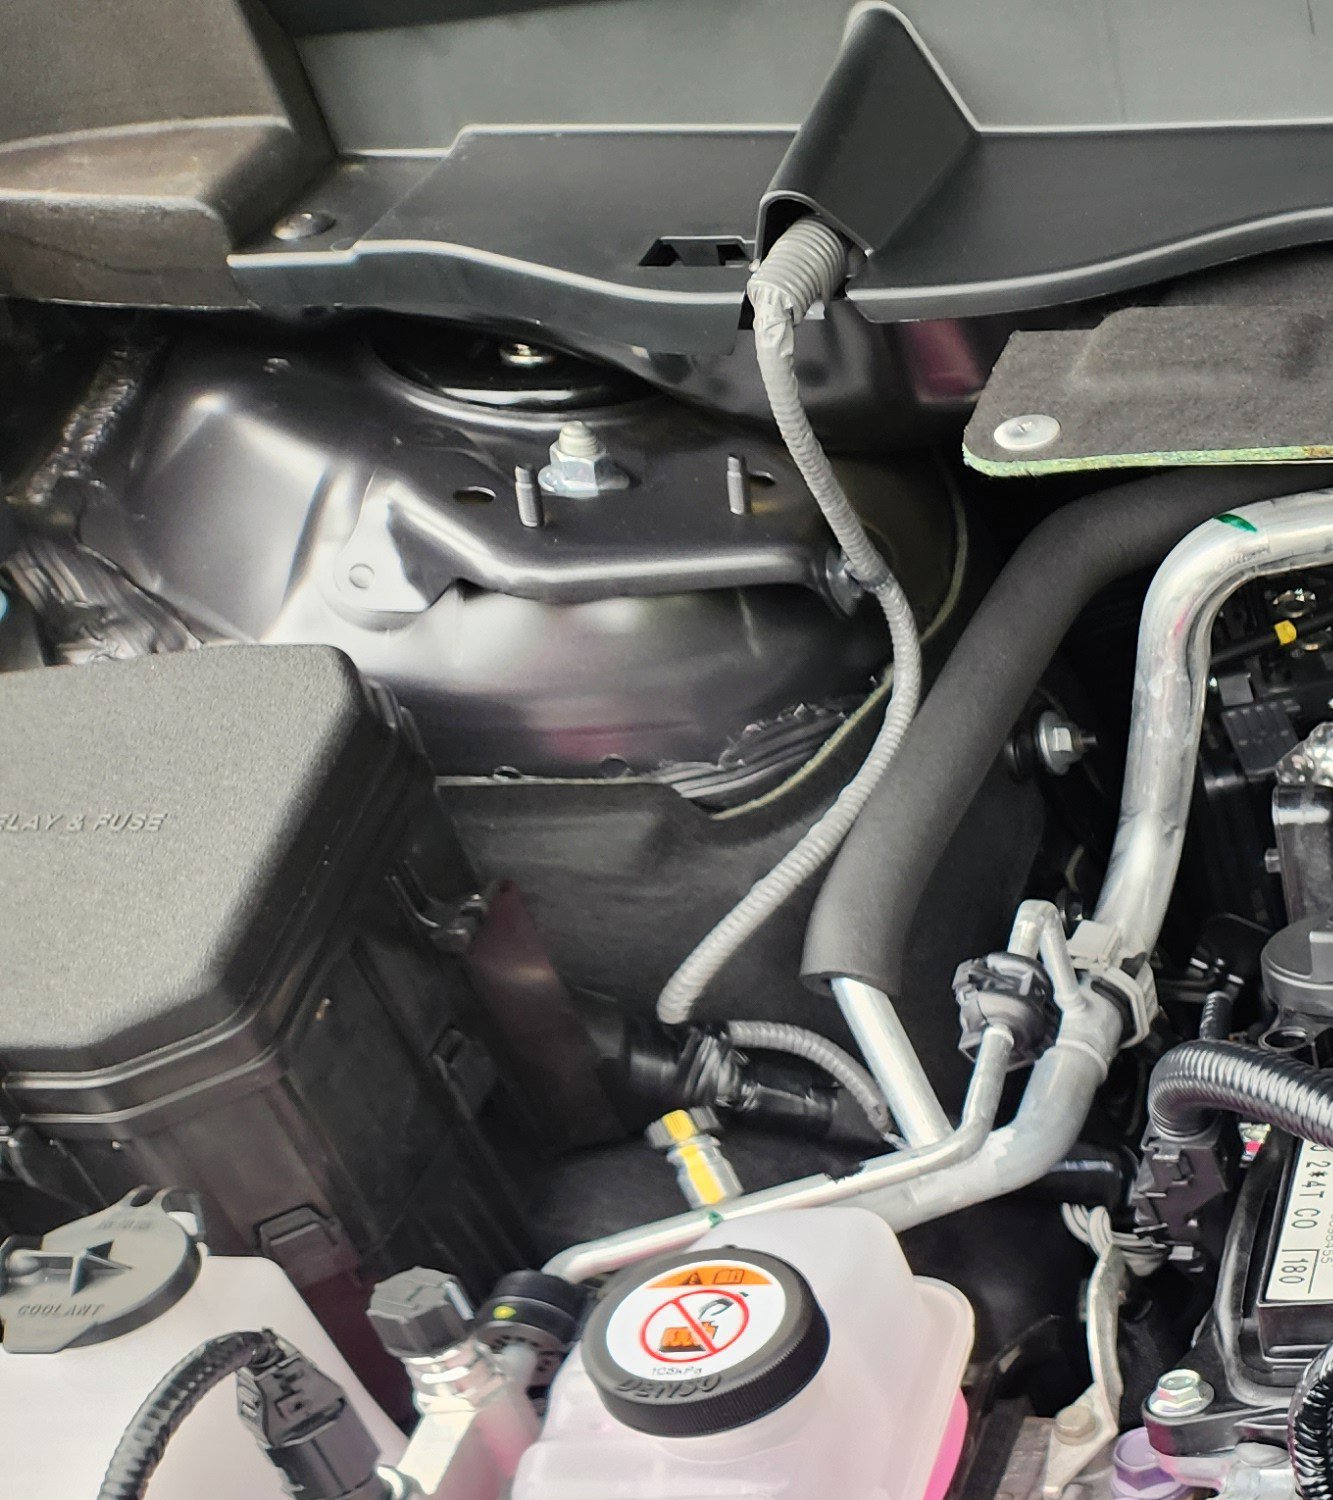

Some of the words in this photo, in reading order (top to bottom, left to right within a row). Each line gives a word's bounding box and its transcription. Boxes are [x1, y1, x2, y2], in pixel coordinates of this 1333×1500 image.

[66, 813, 87, 832] &
[93, 812, 168, 832] FUSE
[1278, 1257, 1311, 1285] 180
[17, 1302, 104, 1319] COOLANT
[616, 1373, 722, 1400] DENSO
